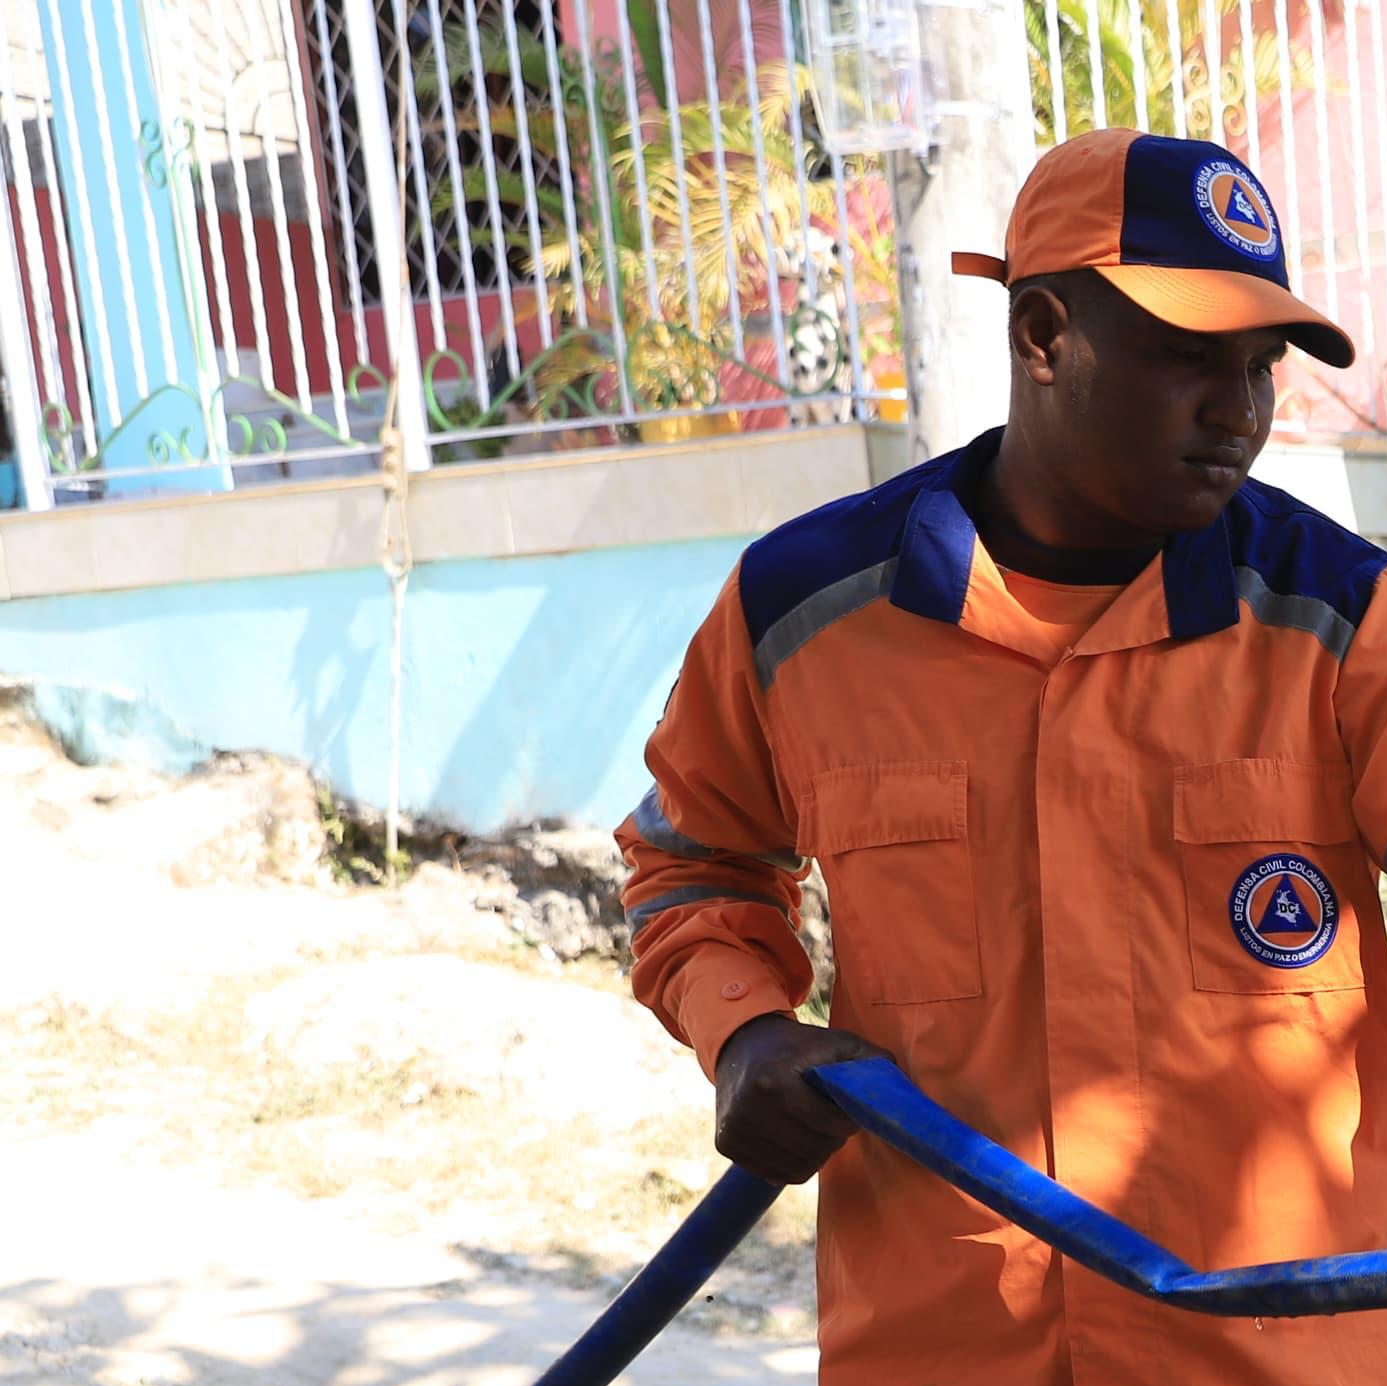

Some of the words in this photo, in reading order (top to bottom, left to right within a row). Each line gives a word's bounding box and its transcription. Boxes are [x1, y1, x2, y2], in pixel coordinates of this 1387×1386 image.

[1196, 166, 1214, 209] DEFENSA
[1211, 161, 1234, 173] CIVIL
[1206, 213, 1229, 238] LISTOS
[1234, 872, 1260, 921] DEFENSA
[1259, 860, 1286, 875] CIVIL
[1289, 861, 1335, 917] COLOMBIANA
[1280, 903, 1296, 914] DC
[1240, 927, 1262, 954] LISTOS
[1262, 950, 1274, 960] EN
[1274, 953, 1291, 962] PAZ
